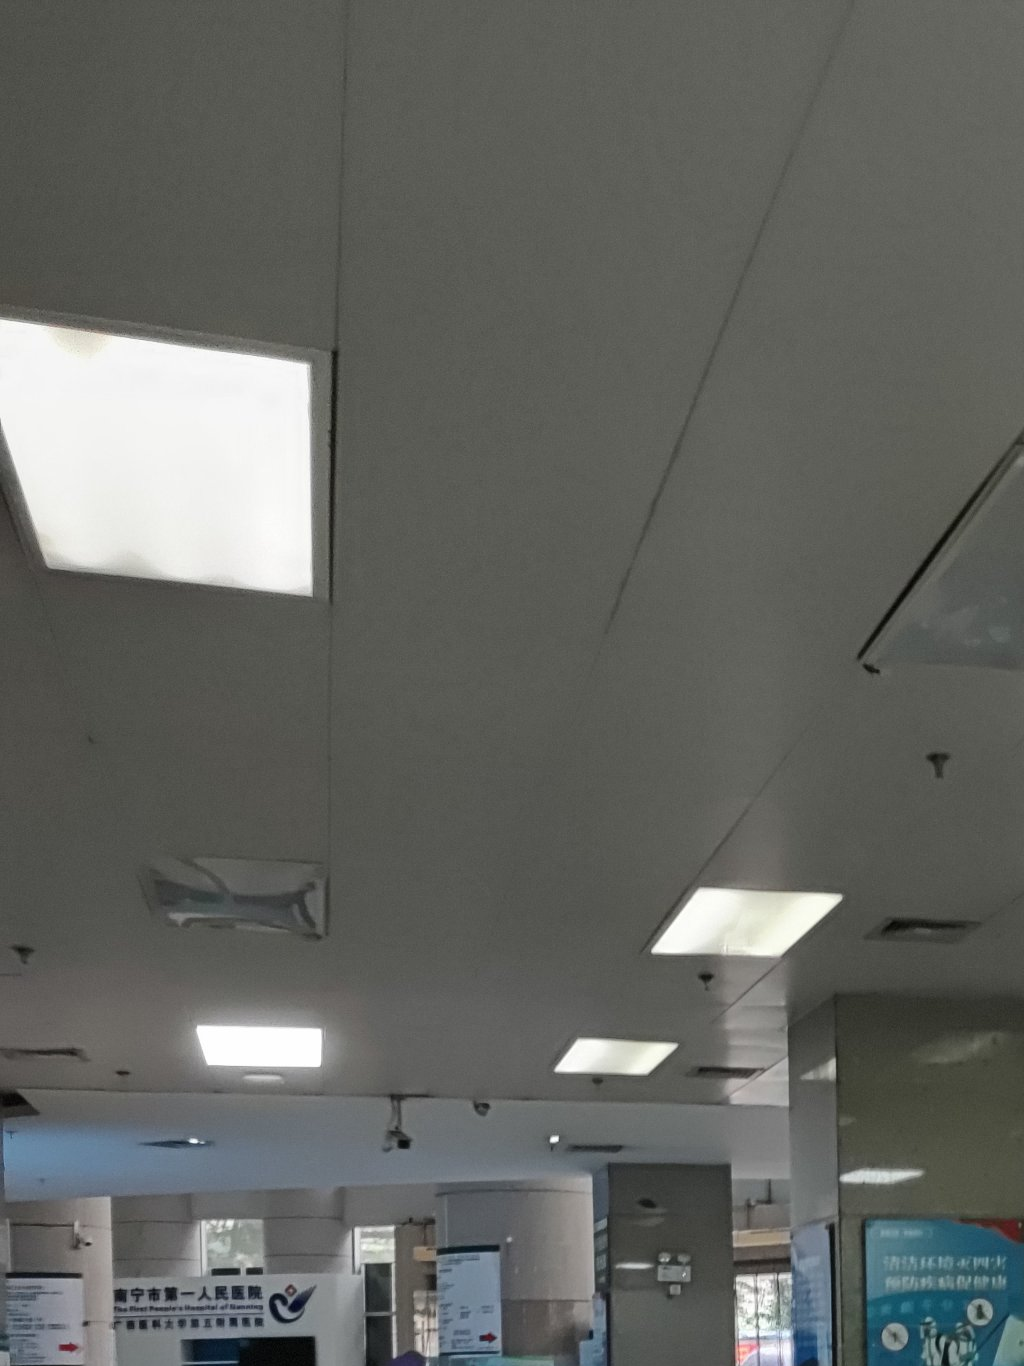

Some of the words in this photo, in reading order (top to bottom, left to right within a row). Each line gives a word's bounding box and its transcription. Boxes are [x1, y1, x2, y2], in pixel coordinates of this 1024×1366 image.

[114, 1285, 263, 1302] 南宁市第一人民医院
